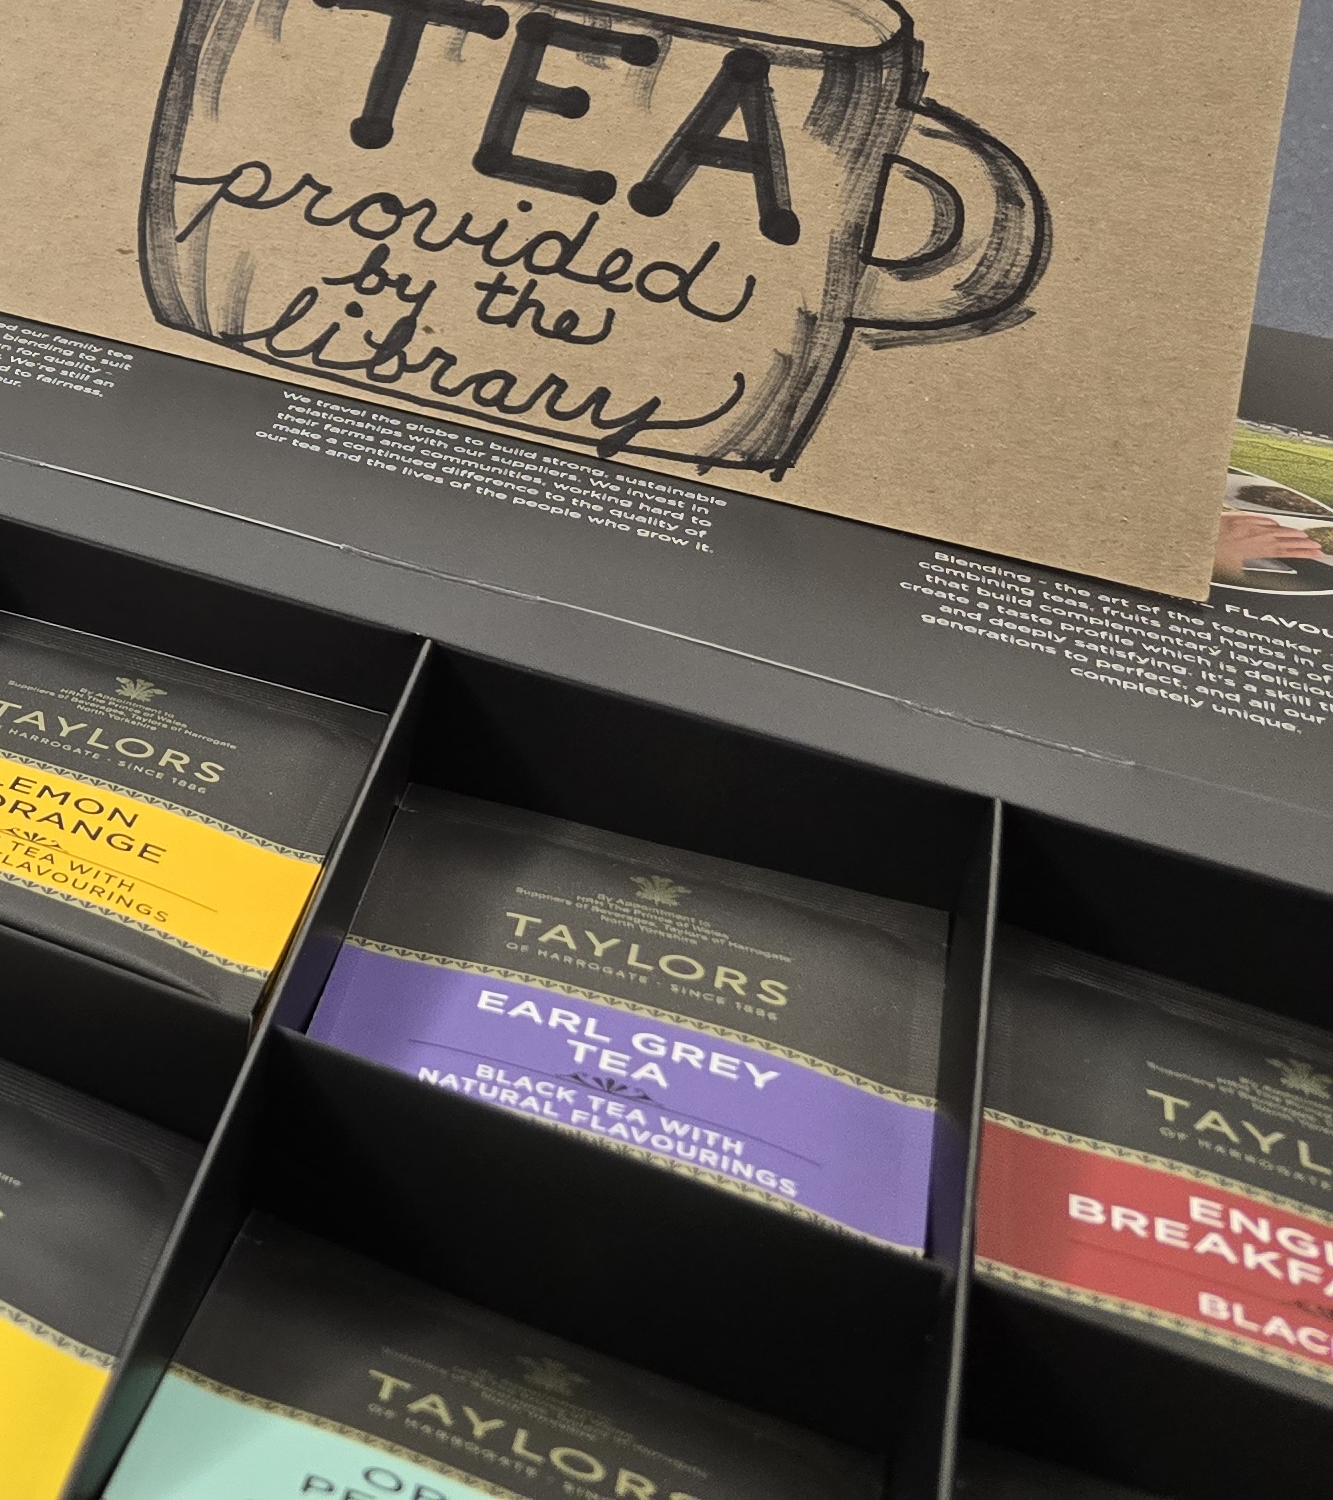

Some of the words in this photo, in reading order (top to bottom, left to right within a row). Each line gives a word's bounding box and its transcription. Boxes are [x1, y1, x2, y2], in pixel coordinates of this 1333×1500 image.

[170, 160, 757, 322] provided
[20, 328, 50, 340] our
[52, 334, 104, 354] family
[106, 348, 134, 362] tea
[323, 244, 437, 326] by
[476, 271, 615, 346] the
[221, 285, 746, 459] library
[282, 390, 312, 404] We
[316, 399, 367, 418] travel
[371, 412, 402, 426] the
[405, 422, 460, 441] globe
[463, 435, 485, 447] to
[488, 441, 538, 461] build
[541, 455, 610, 480] strong,
[614, 473, 728, 508] sustainable
[10, 839, 57, 864] TEA
[68, 857, 138, 893] WITH
[504, 911, 791, 1007] TAYLORS
[476, 990, 612, 1042] EARL
[630, 1032, 781, 1091] GREY
[565, 1037, 671, 1089] TEA
[417, 1067, 561, 1116] NATURAL
[569, 1106, 799, 1200] FLAVOURINGS
[475, 1063, 577, 1104] BLACK
[587, 1093, 648, 1125] TEA
[659, 1116, 747, 1157] WITH
